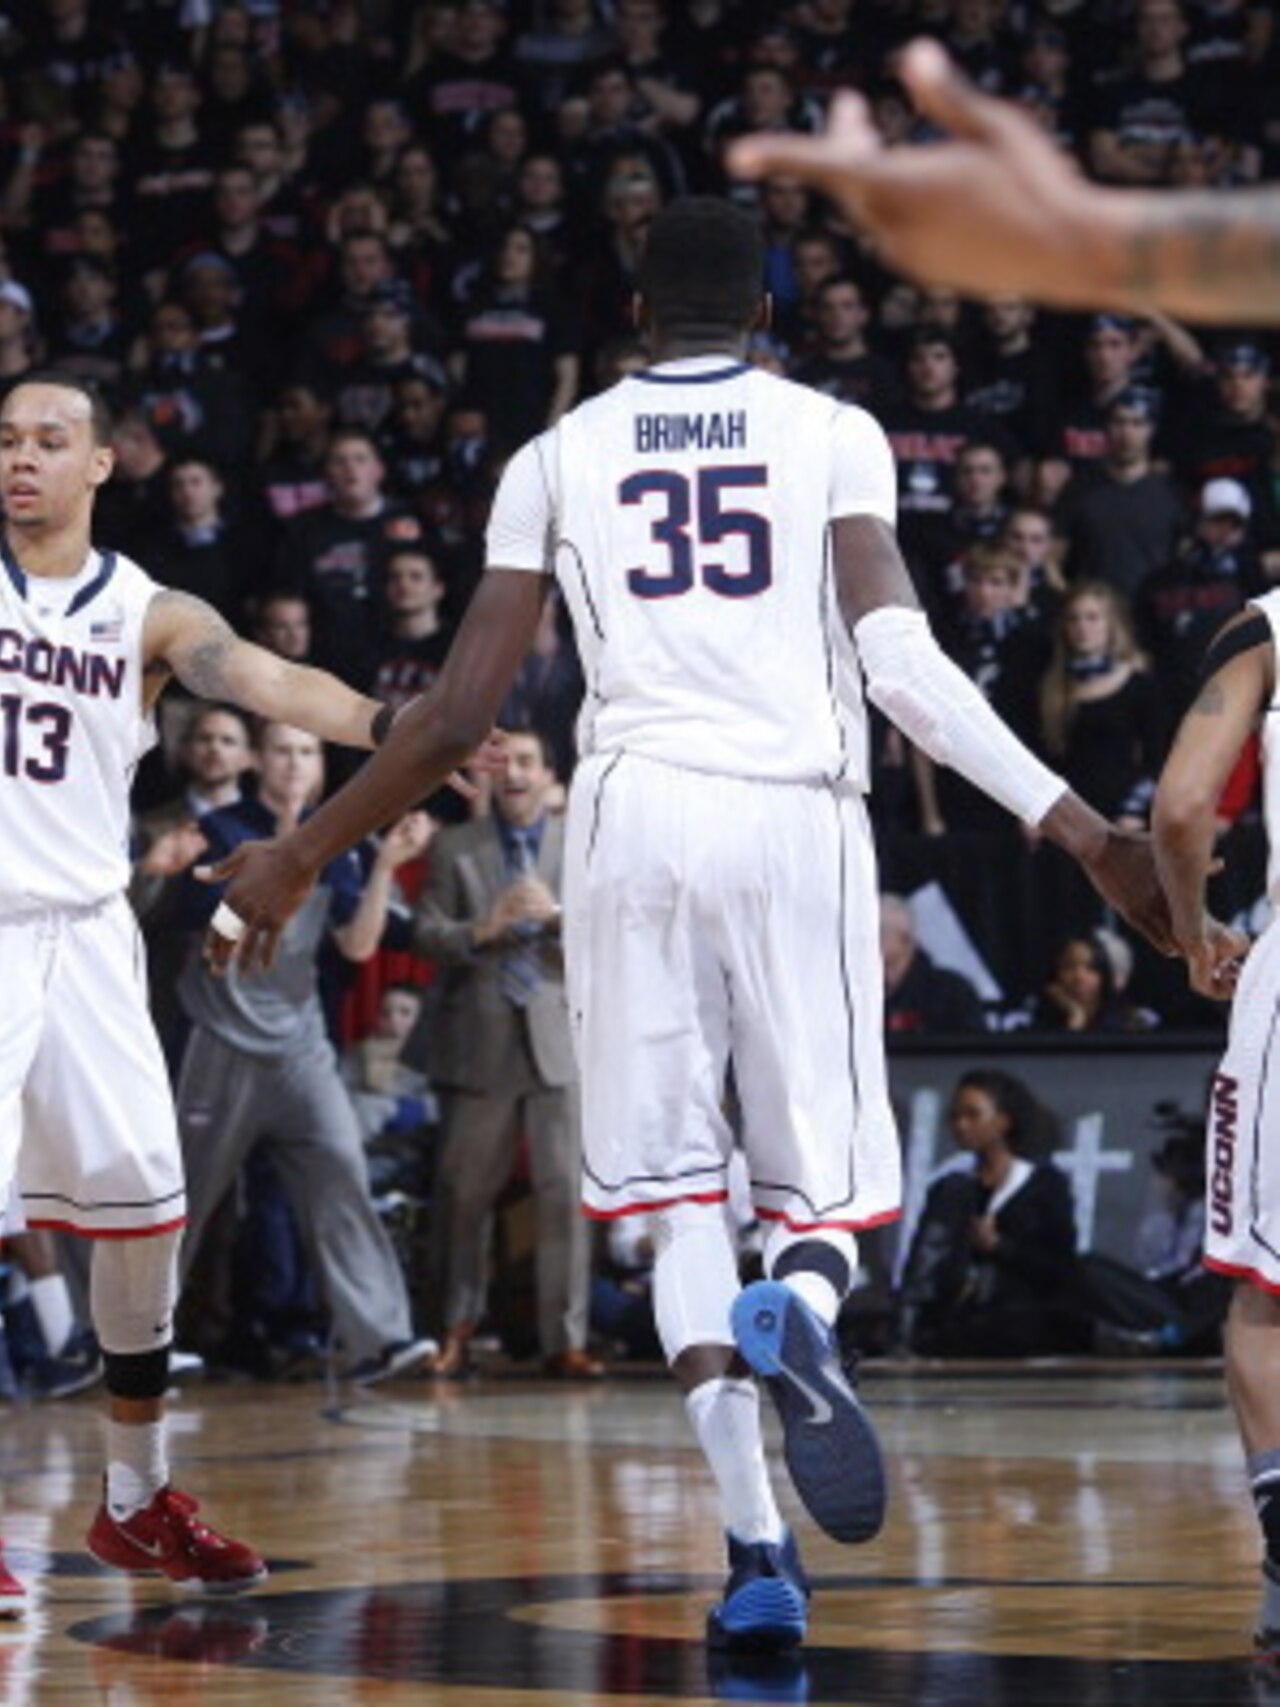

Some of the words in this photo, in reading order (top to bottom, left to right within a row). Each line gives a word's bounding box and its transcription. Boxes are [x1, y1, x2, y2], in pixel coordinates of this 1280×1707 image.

[634, 409, 747, 452] BRIMAH
[617, 465, 773, 600] 35
[0, 693, 73, 784] 13
[1208, 1070, 1239, 1238] UCONN
